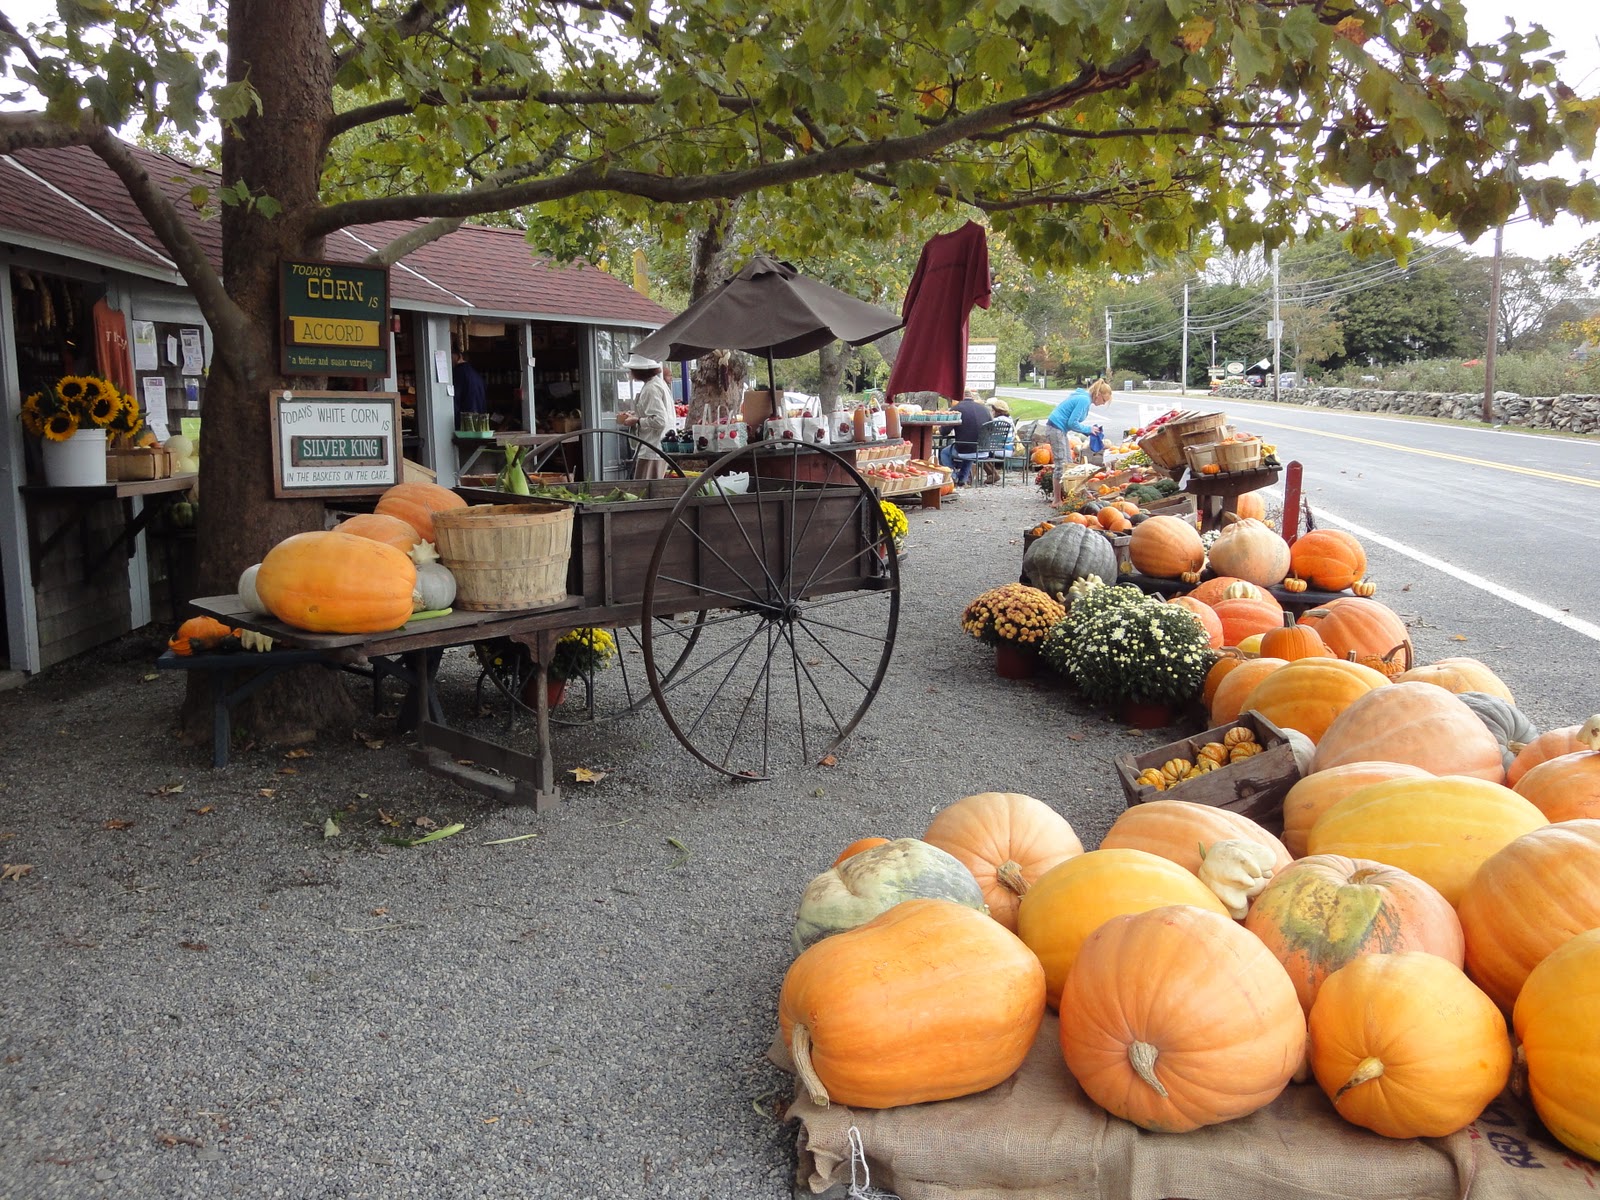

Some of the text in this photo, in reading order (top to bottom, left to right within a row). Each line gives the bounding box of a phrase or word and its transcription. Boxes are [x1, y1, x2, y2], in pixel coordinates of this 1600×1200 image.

[308, 277, 379, 308] CORN IS
[302, 323, 364, 342] ACCORD
[298, 356, 317, 365] butter
[318, 357, 329, 366] and
[331, 359, 347, 367] sugar
[318, 408, 346, 422] WHITE
[351, 408, 379, 423] CORN
[381, 420, 391, 431] IS
[303, 439, 379, 457] SILVER KING
[287, 472, 294, 482] IN
[297, 472, 310, 482] THE
[312, 471, 340, 481] BASKETS
[344, 471, 354, 480] ON
[356, 470, 369, 480] THE
